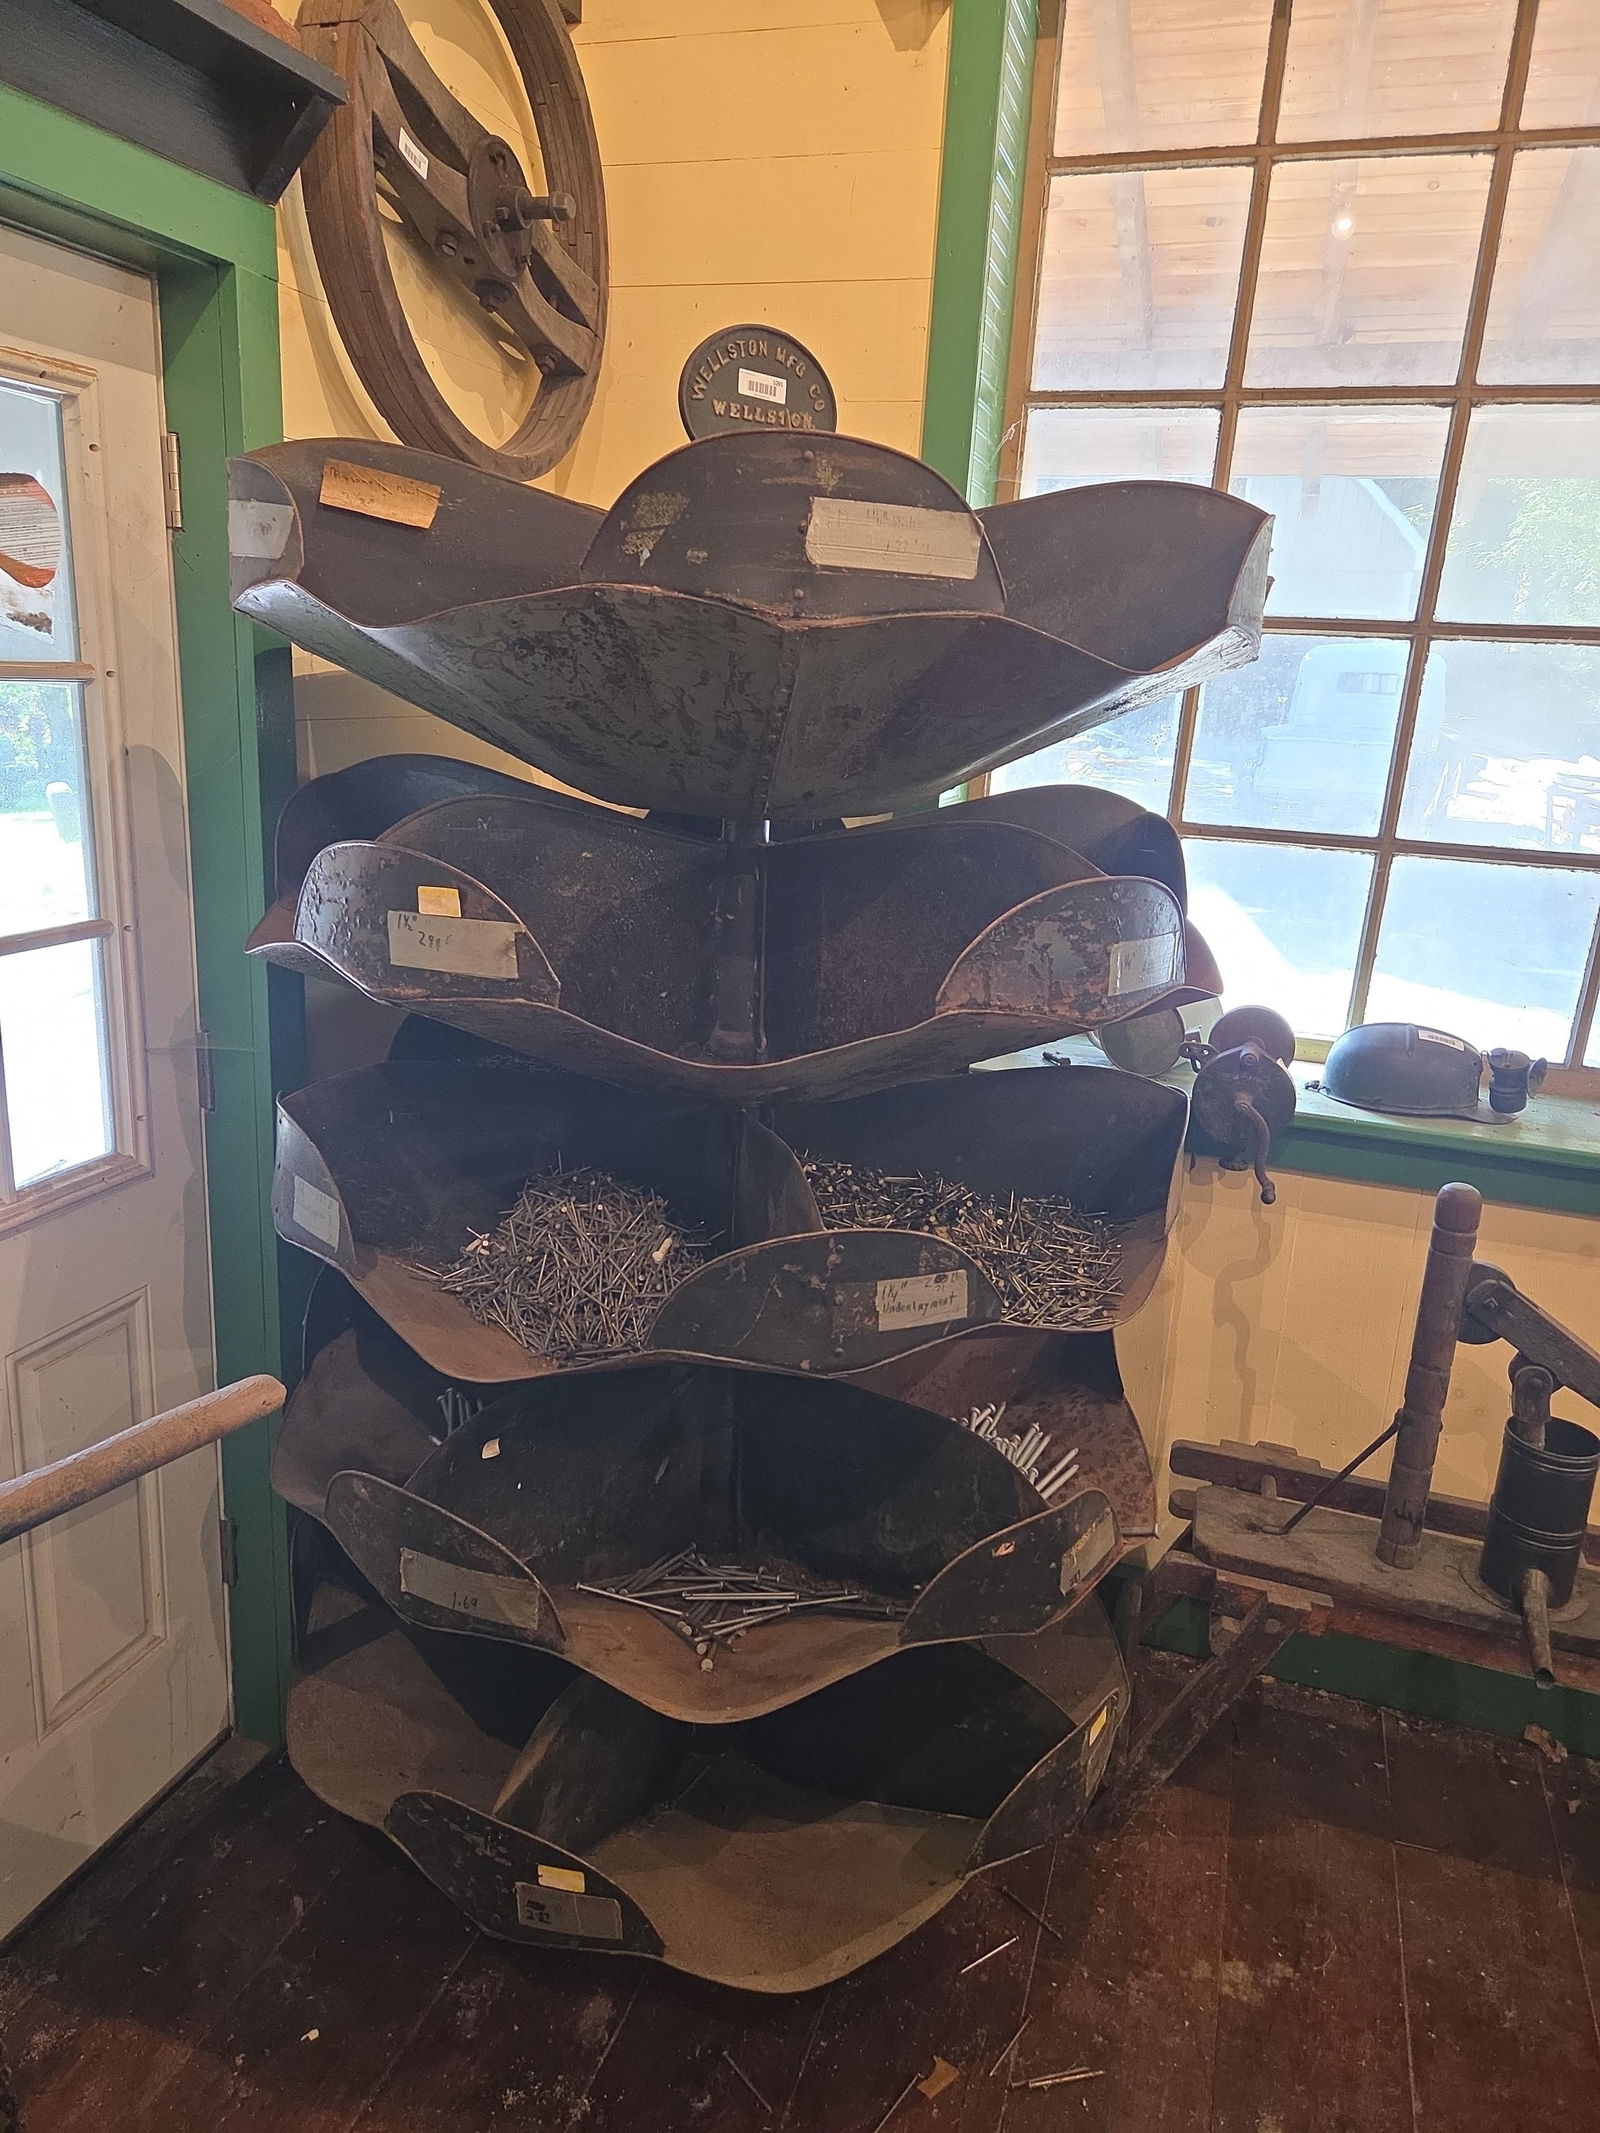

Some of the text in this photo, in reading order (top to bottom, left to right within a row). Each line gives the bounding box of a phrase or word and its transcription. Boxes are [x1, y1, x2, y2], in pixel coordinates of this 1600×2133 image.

[691, 339, 825, 412] WELLSTON MFG CO
